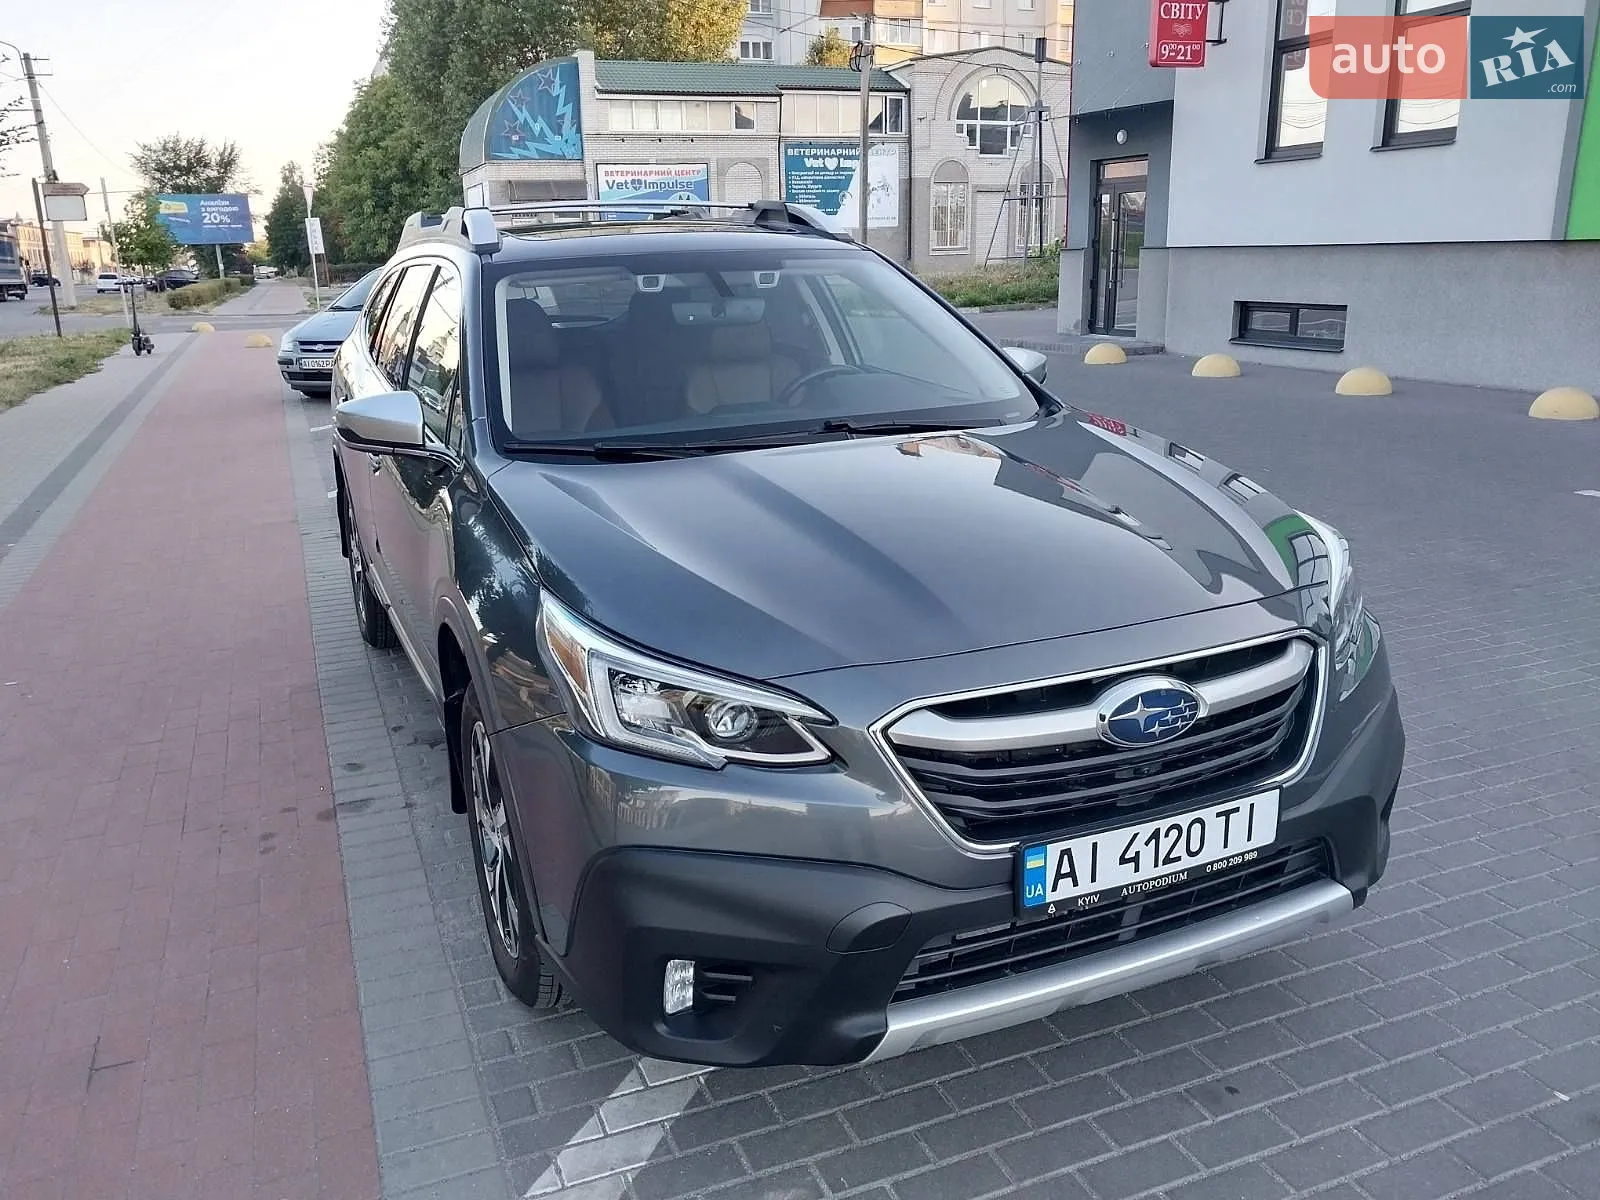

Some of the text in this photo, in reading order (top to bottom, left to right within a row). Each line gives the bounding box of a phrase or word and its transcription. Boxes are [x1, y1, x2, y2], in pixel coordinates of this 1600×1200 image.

[1160, 2, 1206, 20] СВІТУ
[604, 168, 702, 177] ВЕТЕРИНАРНИЙ ЦЕНТР
[605, 179, 694, 192] Vet Impulse
[202, 212, 231, 223] 20%
[1051, 803, 1255, 893] AI 4120 TI
[1077, 894, 1100, 906] KYIV
[1120, 871, 1188, 896] AUTOPODIUM
[1212, 859, 1227, 871] 800
[1228, 855, 1242, 867] 209
[1026, 884, 1044, 898] UA
